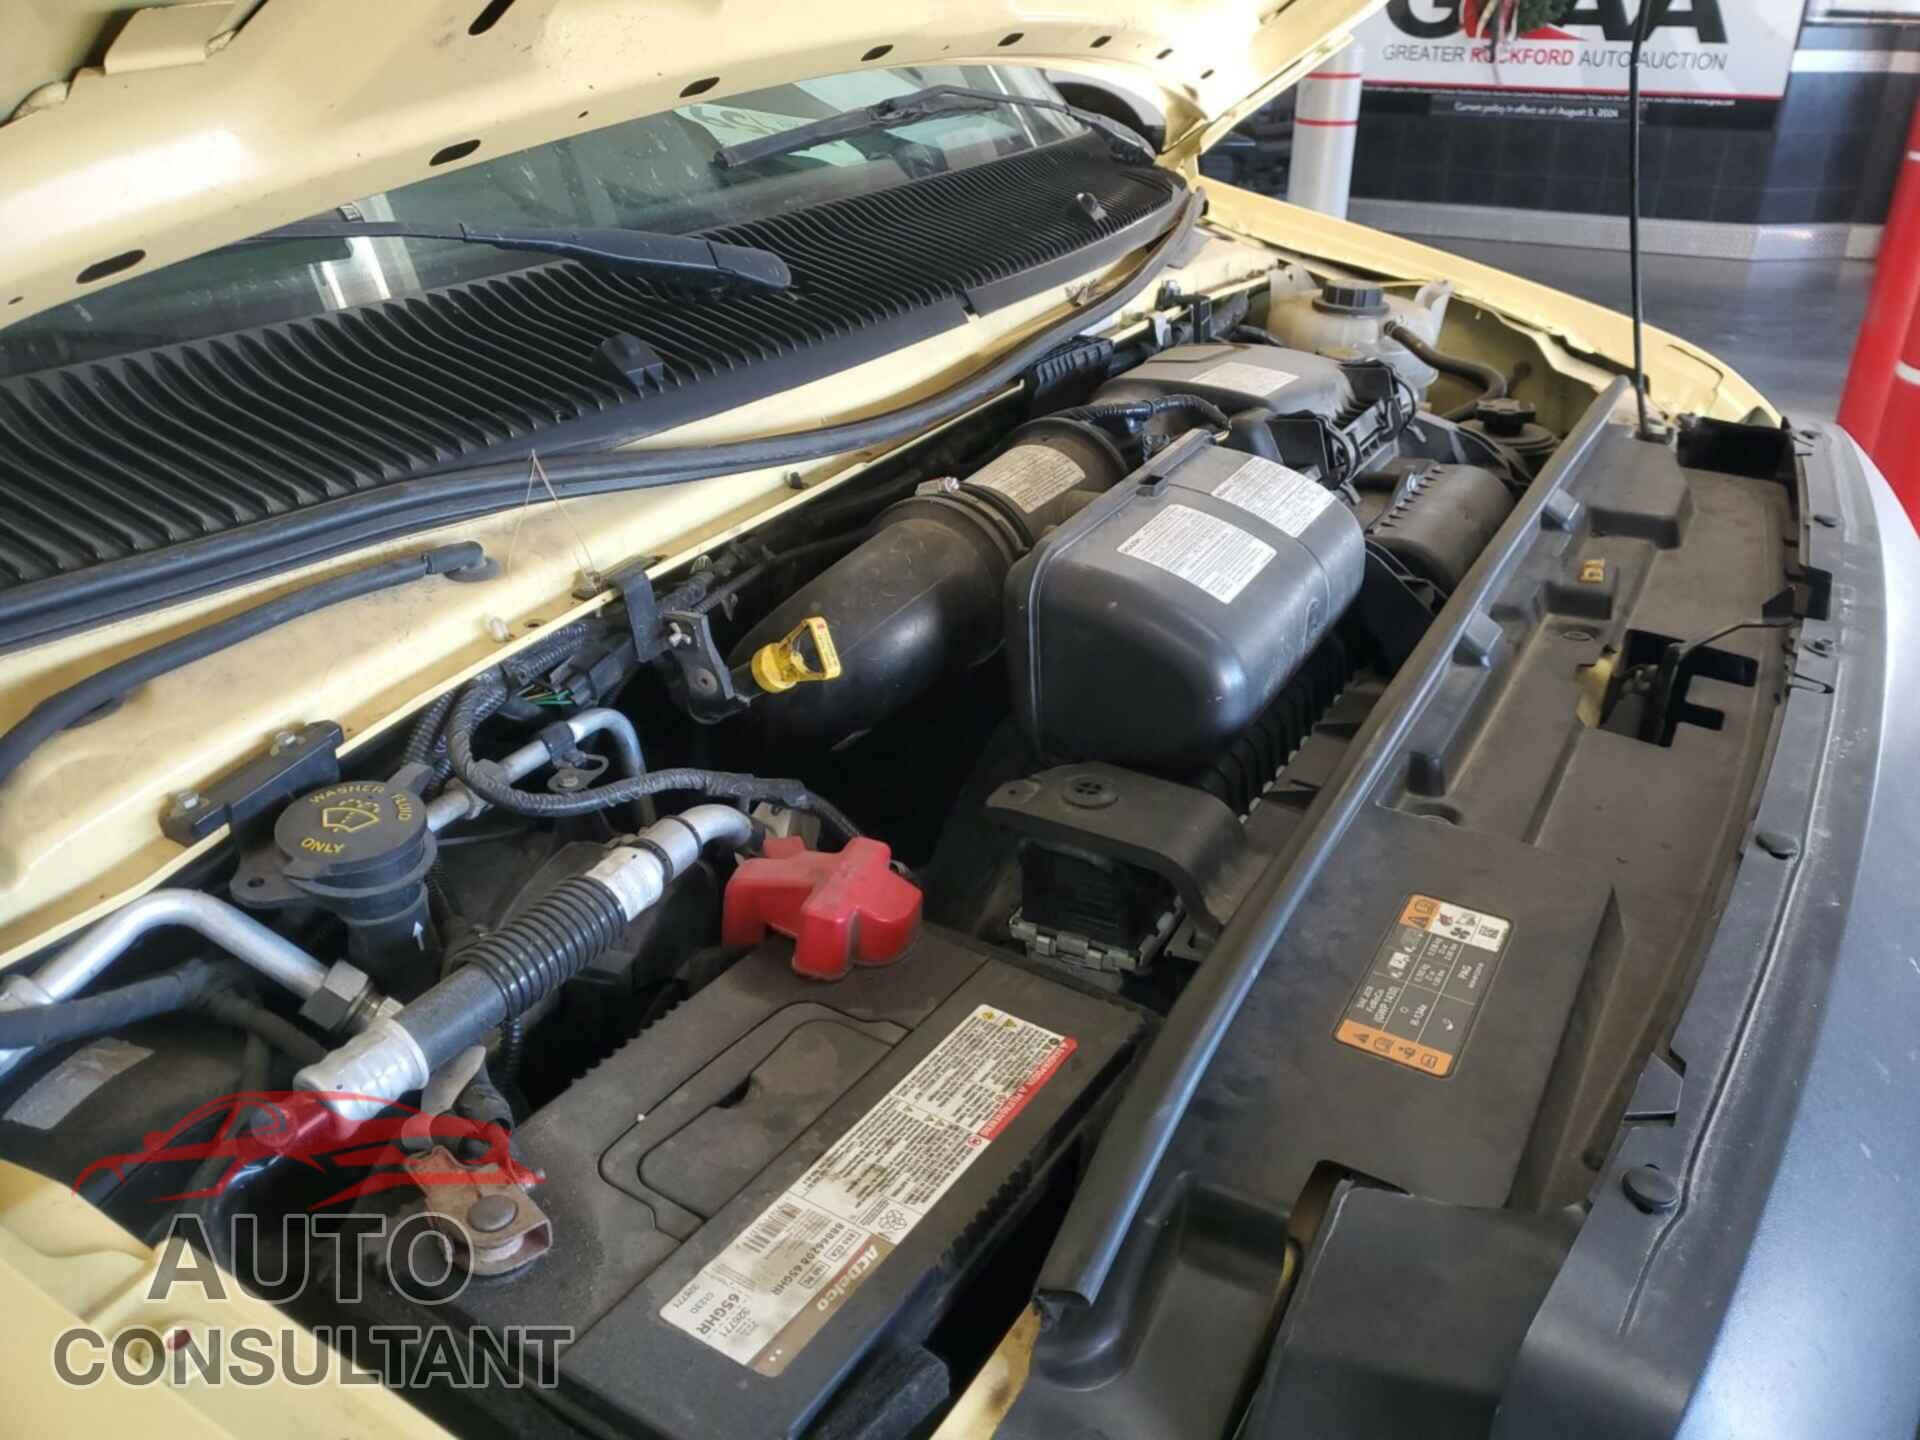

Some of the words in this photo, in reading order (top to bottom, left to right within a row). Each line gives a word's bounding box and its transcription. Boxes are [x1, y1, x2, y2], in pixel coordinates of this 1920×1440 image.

[1383, 44, 1466, 62] GREATER
[1578, 49, 1631, 68] AUTO
[1637, 51, 1728, 71] AUCTION
[309, 785, 384, 804] WASHER
[391, 793, 413, 822] FLUID
[301, 837, 344, 854] ONLY
[812, 1244, 883, 1313] ACDelco
[693, 1291, 742, 1336] 65GHR
